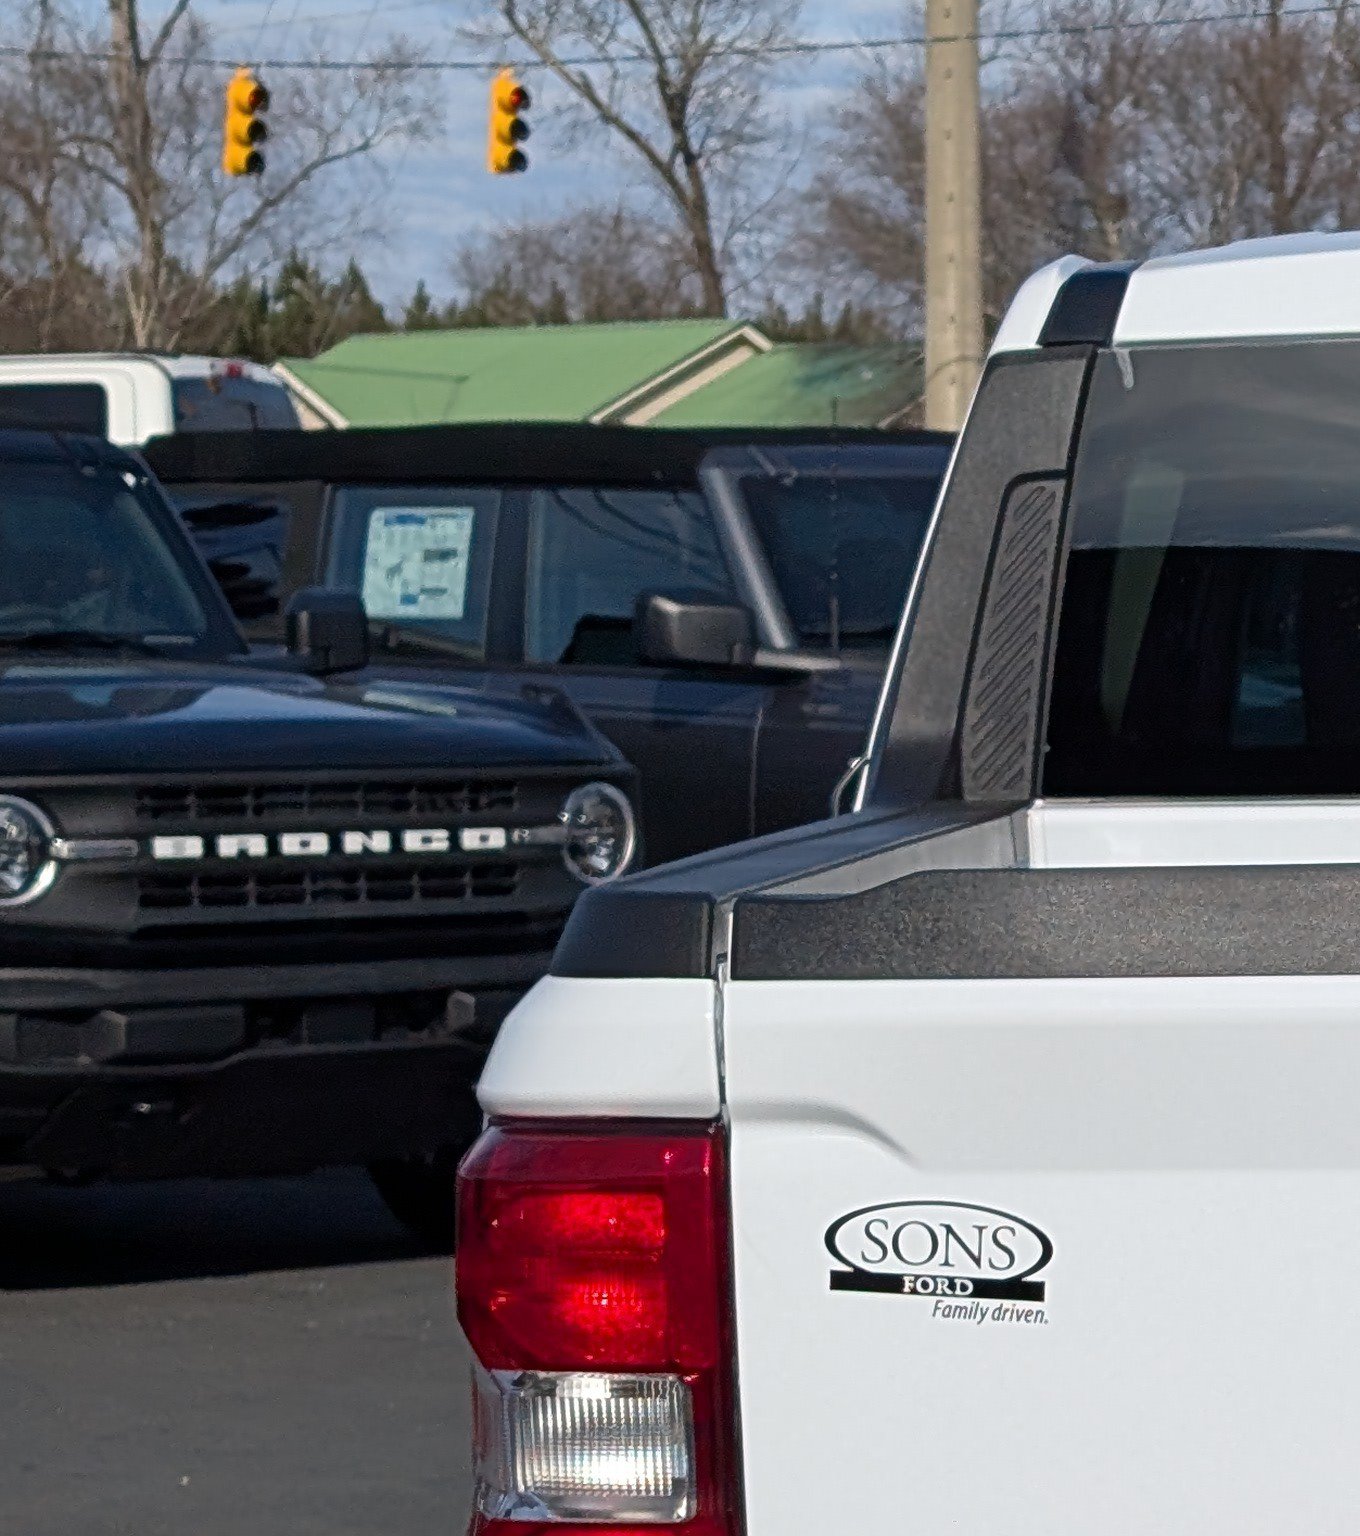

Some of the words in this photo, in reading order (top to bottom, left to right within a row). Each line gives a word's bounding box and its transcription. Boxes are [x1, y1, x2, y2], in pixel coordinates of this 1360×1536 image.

[153, 827, 505, 859] BRONCO
[861, 1218, 1016, 1270] SONS
[903, 1276, 974, 1296] FORD
[932, 1300, 989, 1325] Family
[992, 1303, 1049, 1325] driven.
